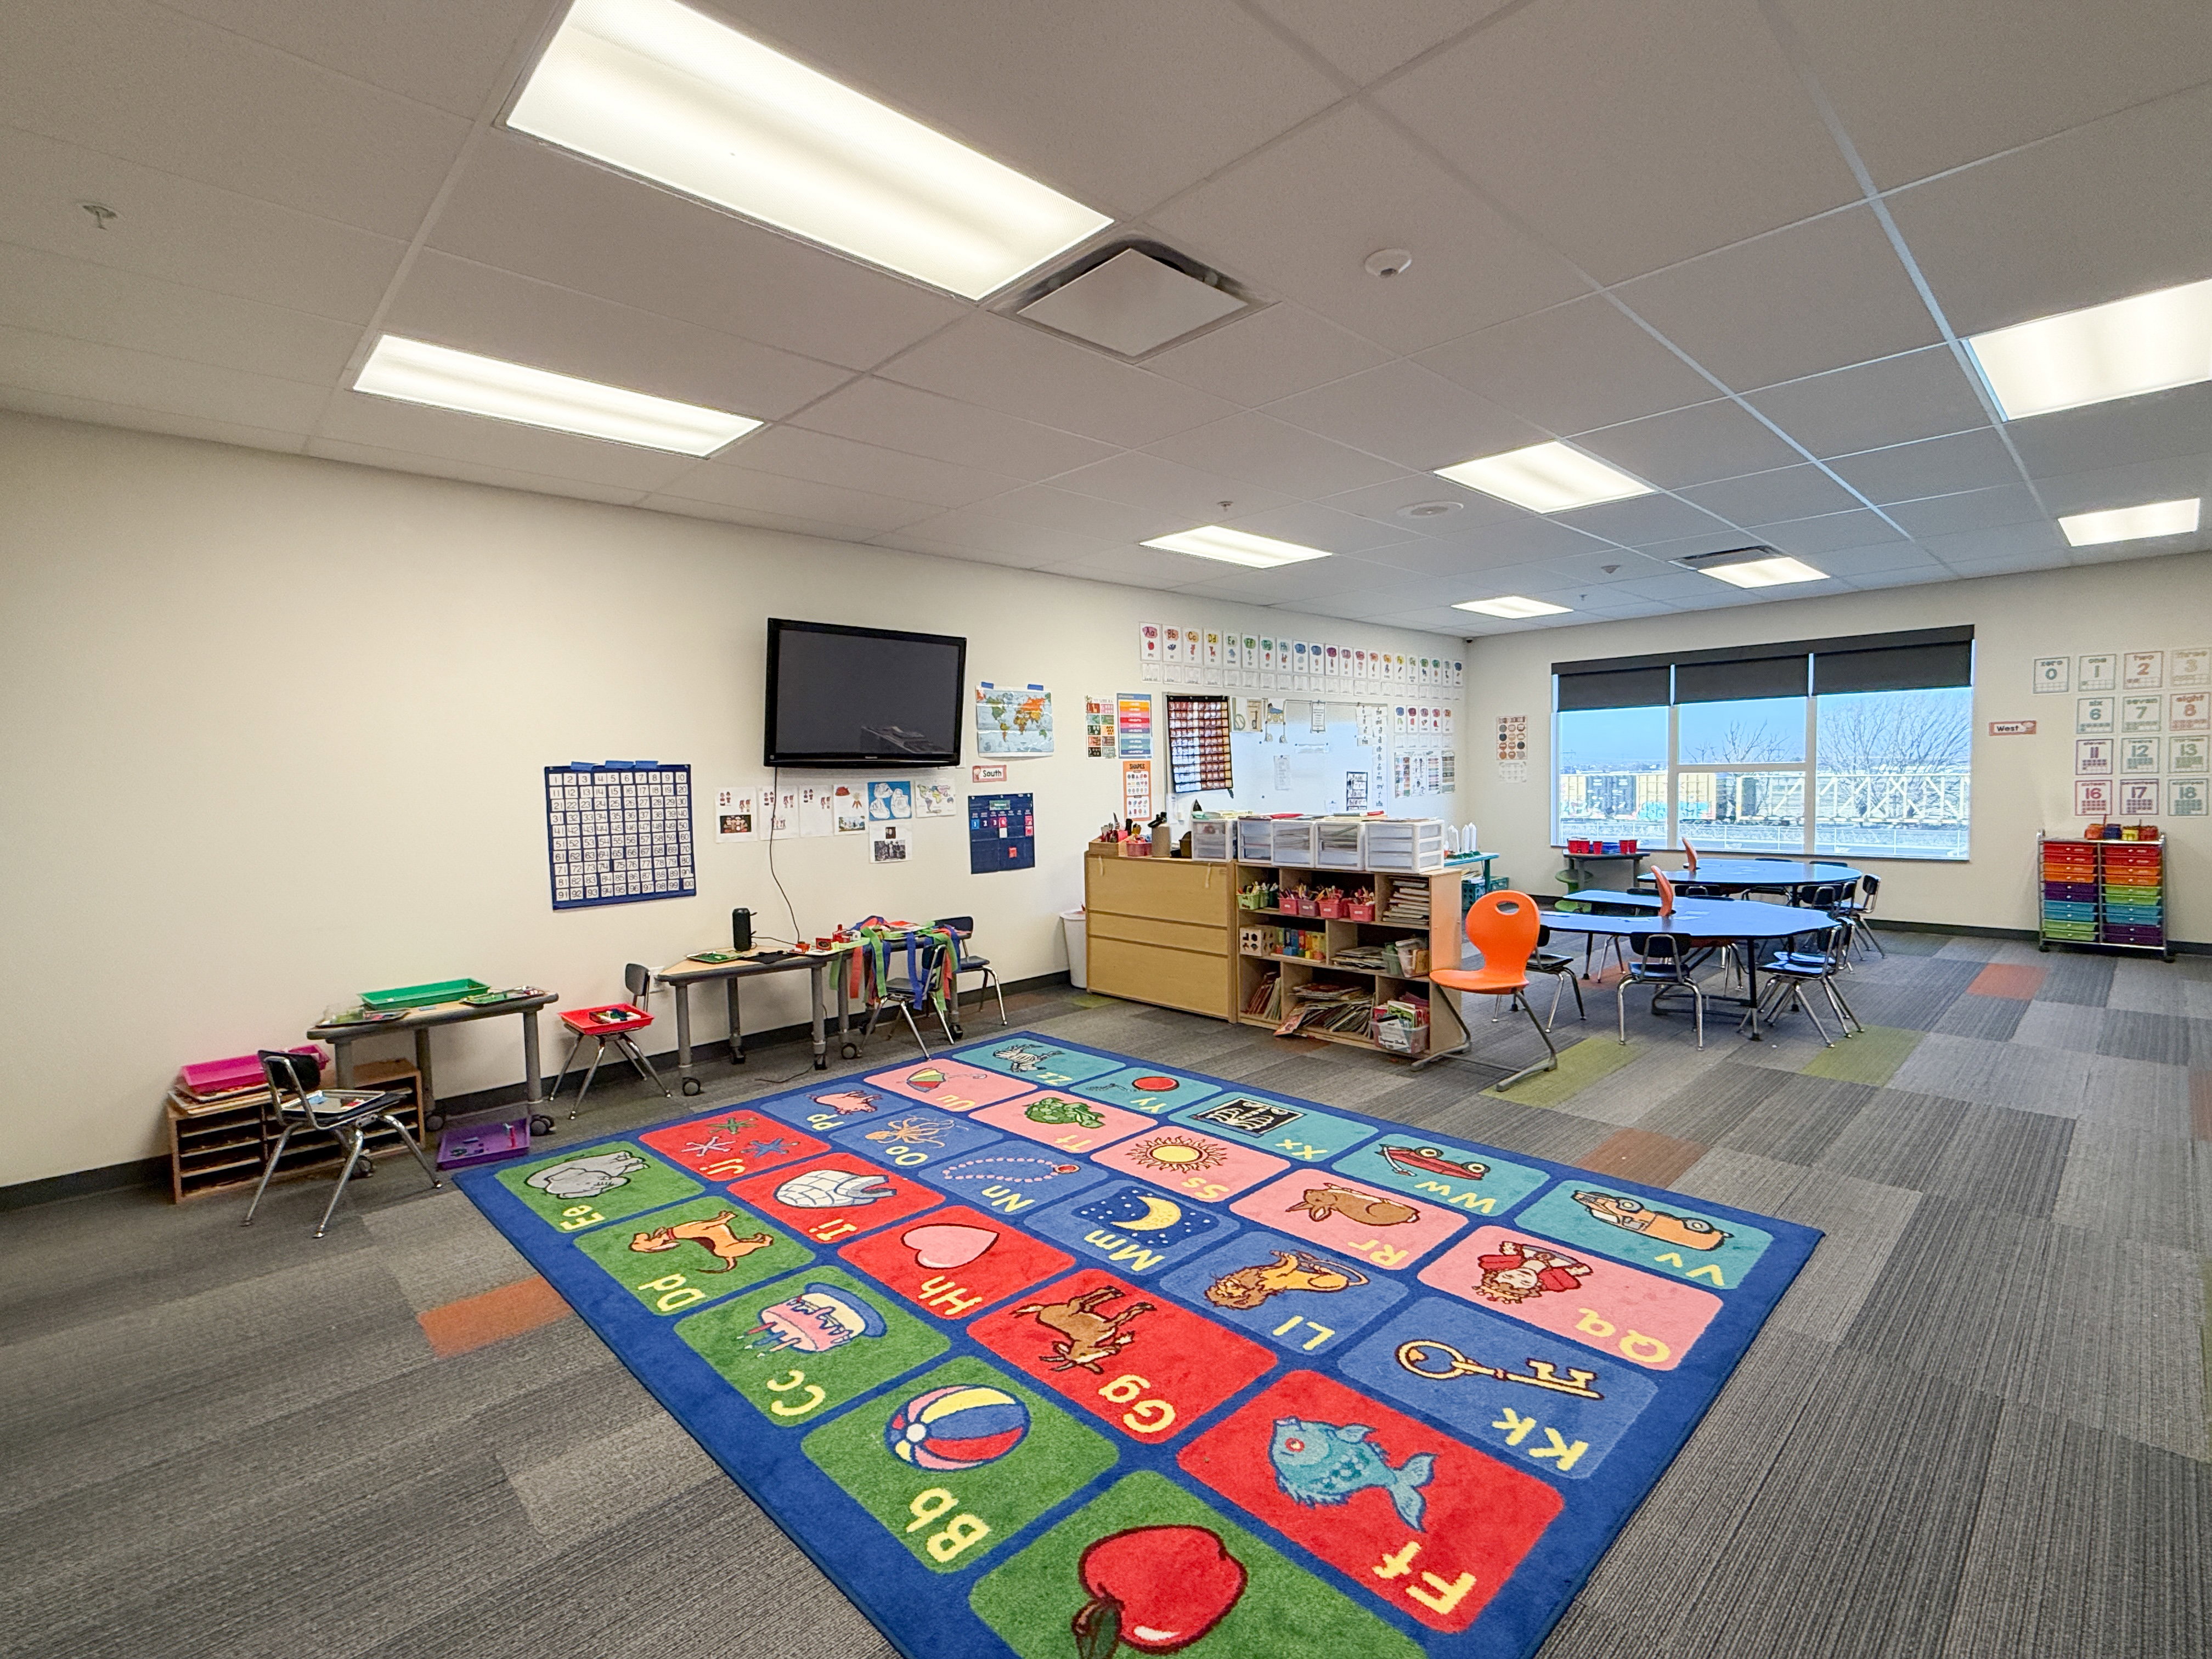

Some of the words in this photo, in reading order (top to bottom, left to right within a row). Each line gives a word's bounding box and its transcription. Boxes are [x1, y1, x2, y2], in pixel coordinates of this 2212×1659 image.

[1146, 627, 1155, 636] Aa
[1168, 629, 1176, 638] Bb
[1188, 631, 1197, 641] Cc
[1208, 634, 1216, 642] Dd
[2045, 668, 2057, 680] 0
[2094, 665, 2100, 678] 1
[2137, 663, 2150, 675] 2
[2185, 659, 2198, 672] 3
[2090, 708, 2101, 720] 6
[2136, 706, 2147, 719] 7
[2184, 704, 2196, 716] 8
[2090, 747, 2099, 758] 11
[2132, 745, 2149, 757] 12
[2180, 743, 2198, 755] 13
[2085, 788, 2102, 799] 16
[2131, 787, 2147, 798] 17
[2180, 786, 2197, 799] 18
[938, 1095, 975, 1110] Uu
[1131, 1097, 1164, 1114] Yy
[807, 1113, 847, 1130] Pp
[887, 1147, 926, 1165] Oo
[1277, 1140, 1326, 1159] Xx
[700, 1158, 746, 1176] Jj
[1182, 1178, 1228, 1198] Ss
[983, 1186, 1032, 1211] Nn
[1415, 1182, 1496, 1212] Ww
[560, 1205, 605, 1229] Ee
[810, 1220, 856, 1240] Ii
[1084, 1229, 1165, 1271] Mm
[1348, 1240, 1408, 1266] Rr
[1655, 1252, 1724, 1286] Vv
[638, 1274, 706, 1311] Dd
[919, 1277, 981, 1314] Hh
[1274, 1317, 1334, 1350] Ll
[1576, 1308, 1670, 1362] Qq
[767, 1370, 825, 1416] Cc
[1099, 1375, 1175, 1432] Gg
[1494, 1409, 1587, 1470] Kk
[906, 1488, 990, 1562] Bb
[1374, 1542, 1475, 1613] Ff
